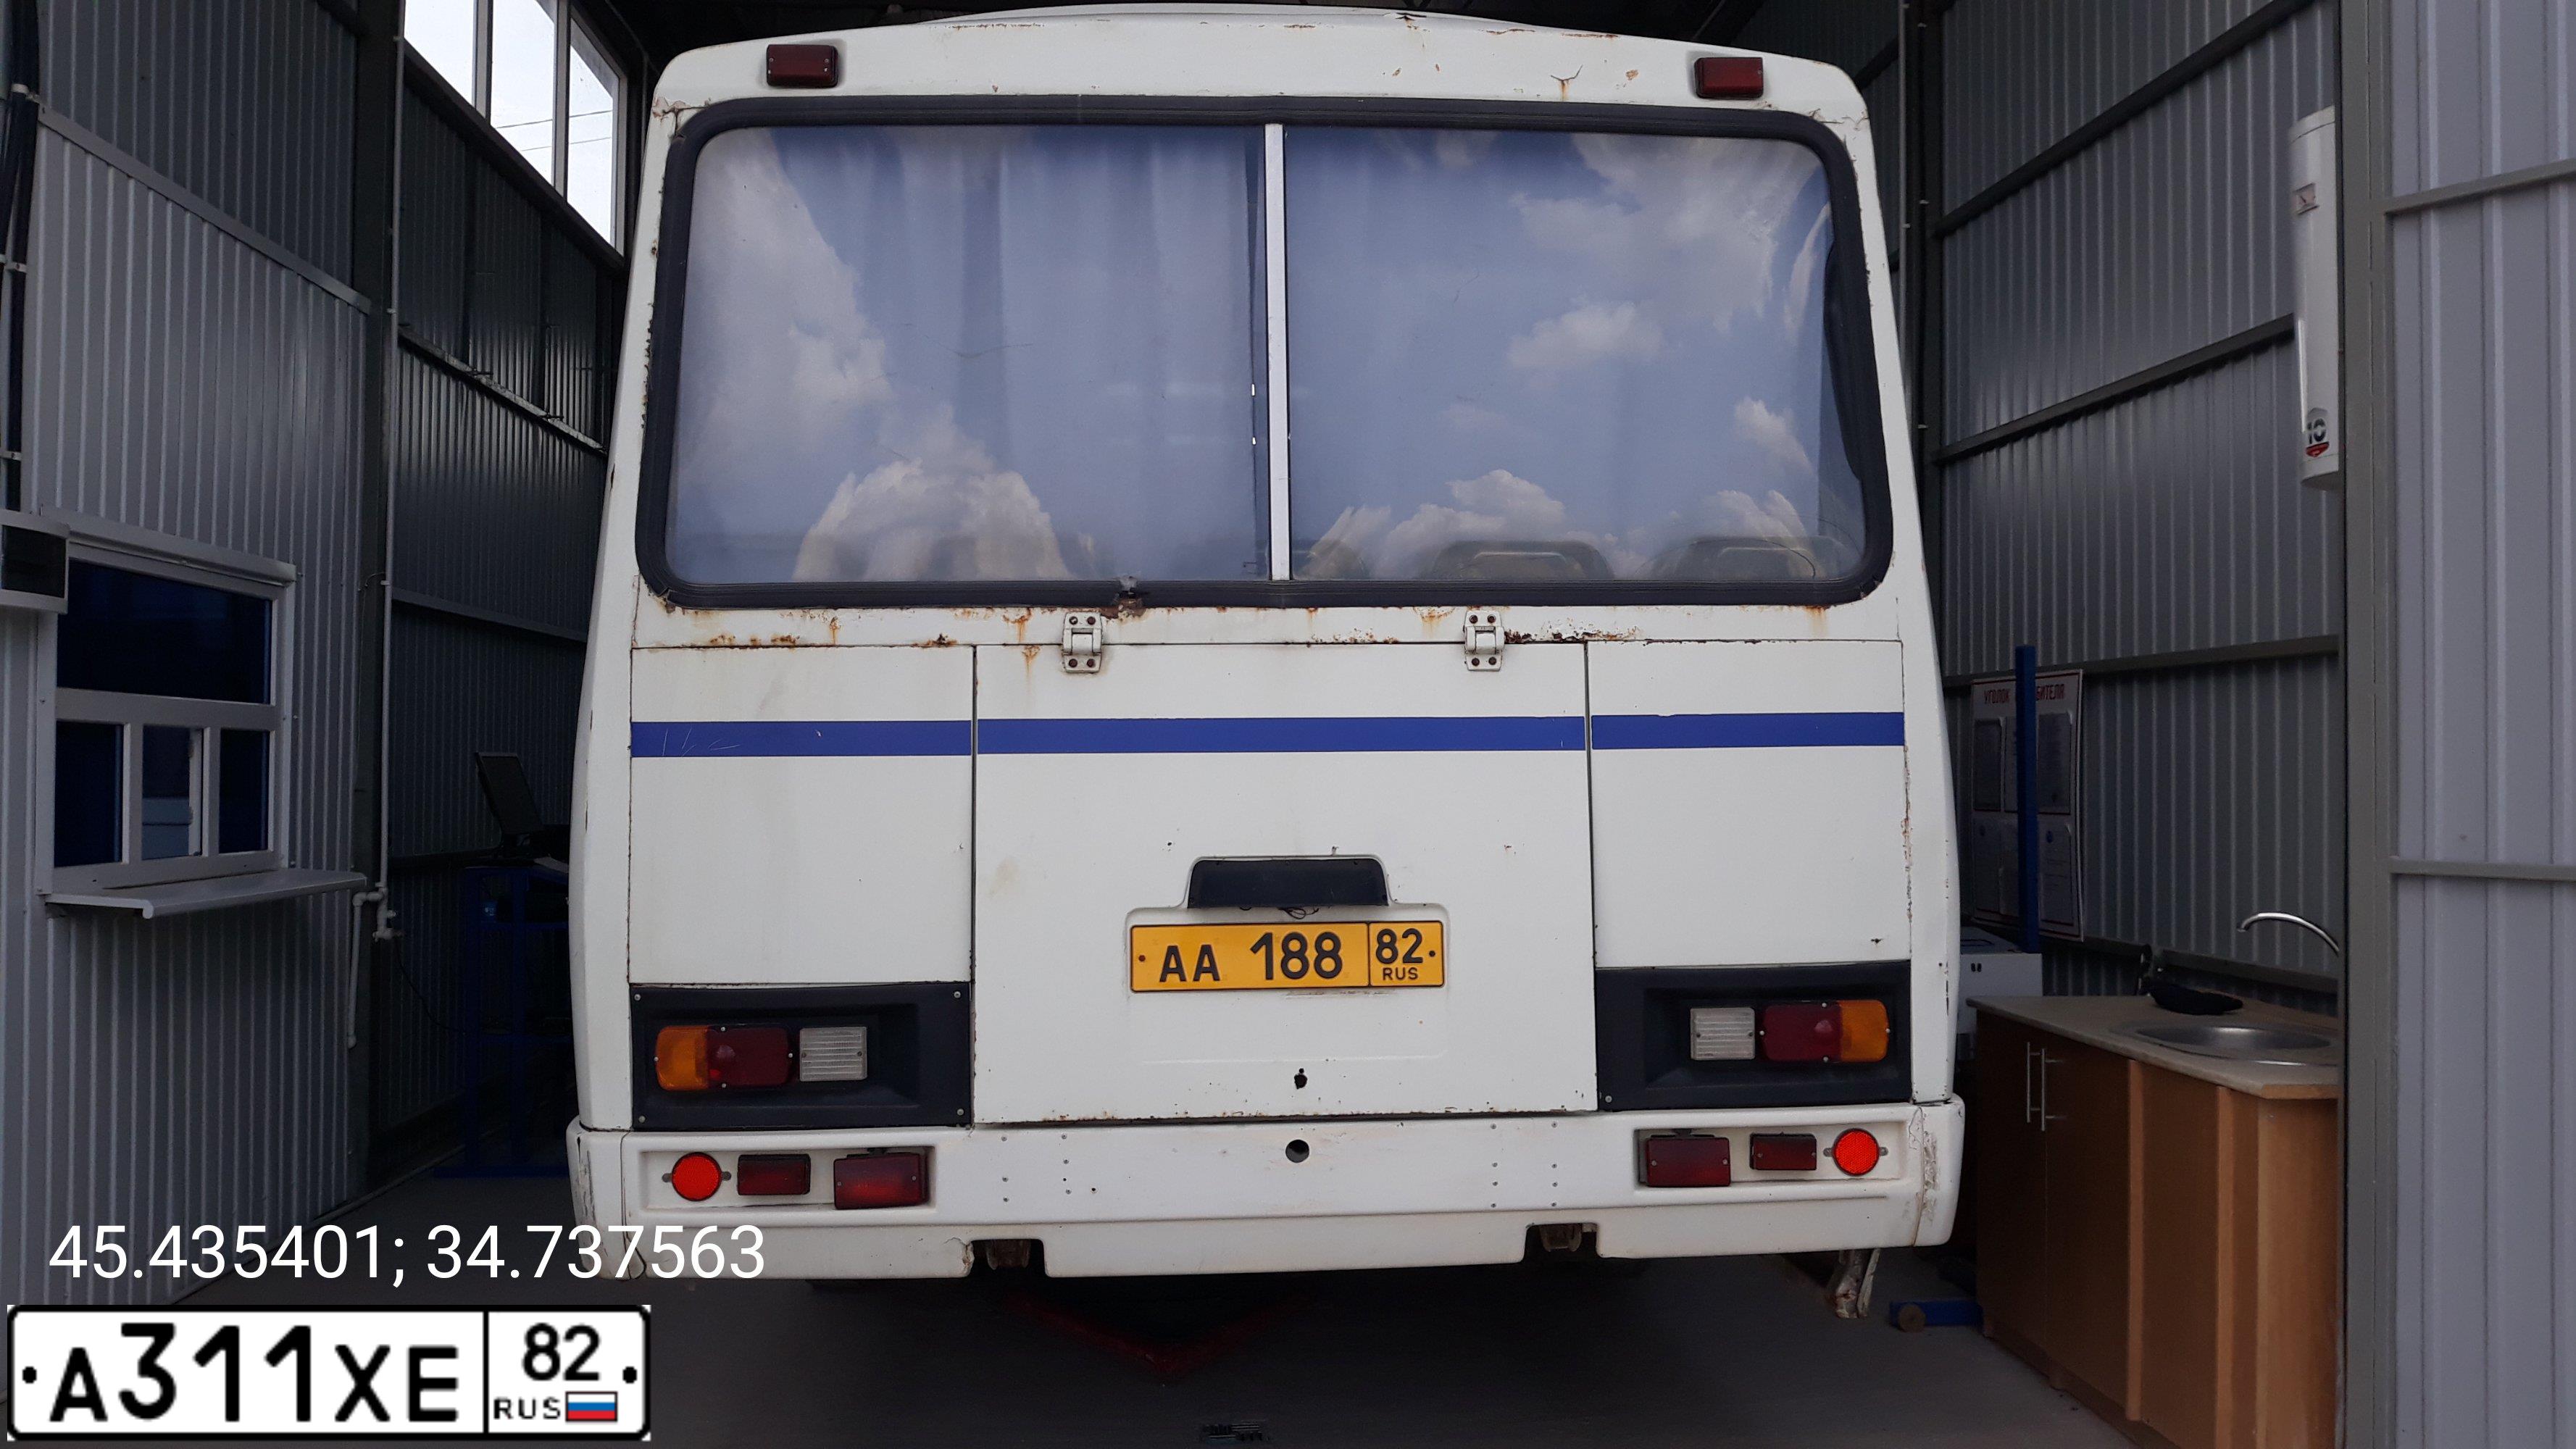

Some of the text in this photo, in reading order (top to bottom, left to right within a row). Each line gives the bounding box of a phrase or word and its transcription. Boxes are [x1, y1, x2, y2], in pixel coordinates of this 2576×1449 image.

[2035, 683, 2065, 701] БИТЕЛЯ
[1250, 931, 1343, 981] 188
[1375, 927, 1424, 965] 82
[1382, 966, 1419, 981] RUS
